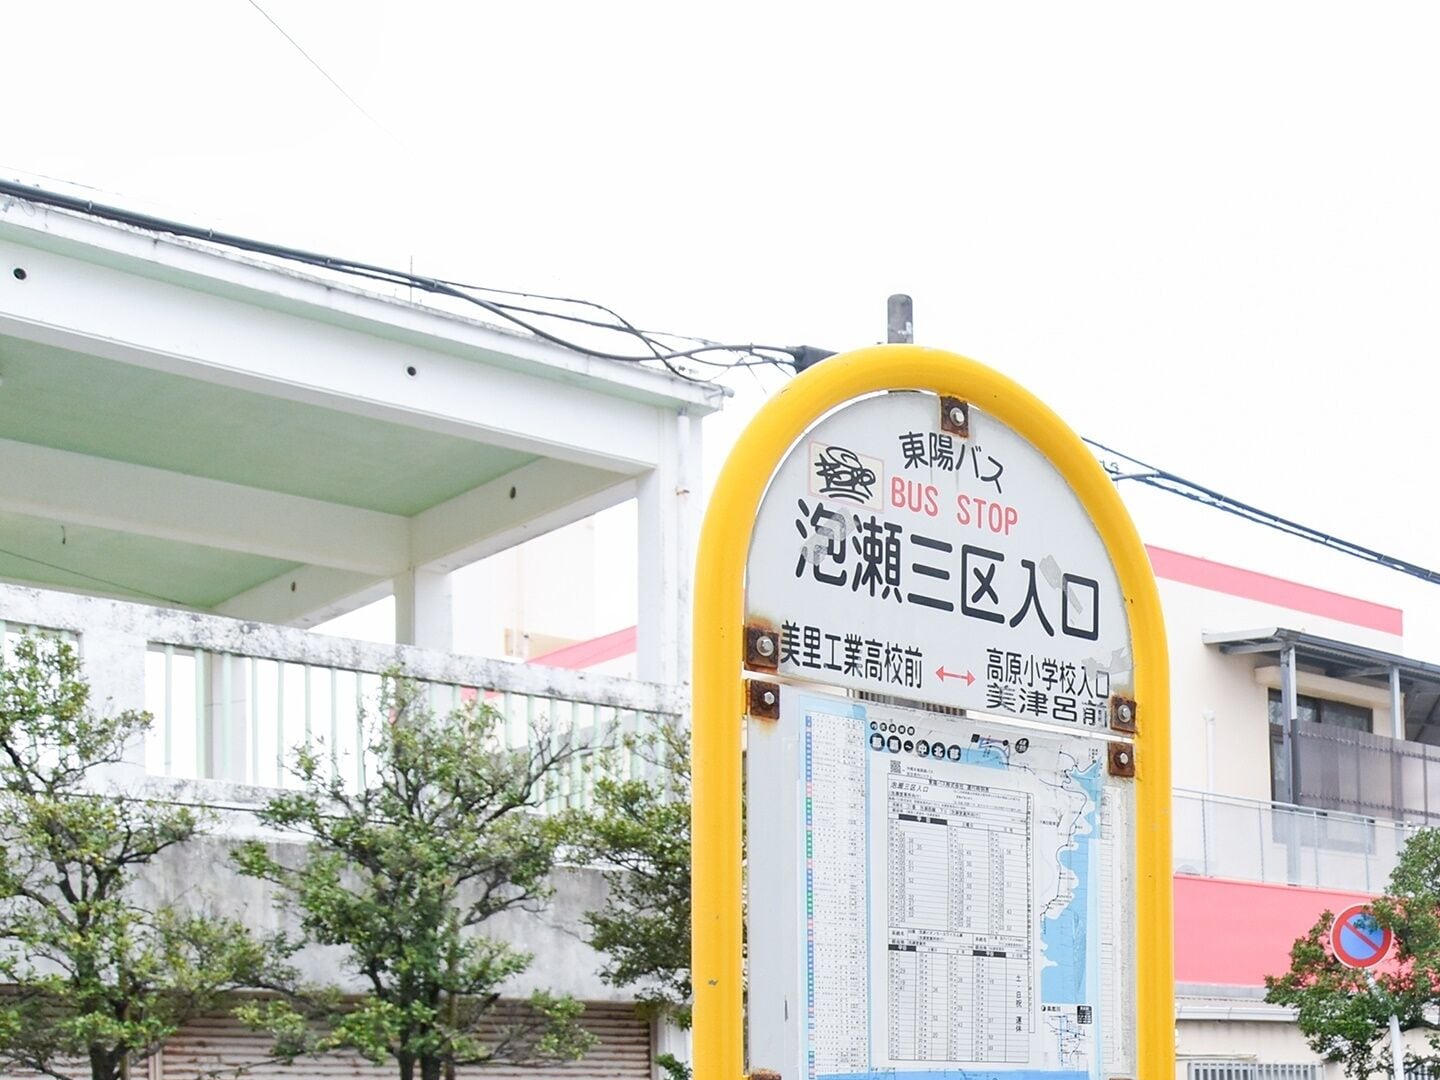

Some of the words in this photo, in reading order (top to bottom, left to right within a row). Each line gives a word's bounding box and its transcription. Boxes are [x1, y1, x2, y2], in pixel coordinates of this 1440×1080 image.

[899, 431, 1004, 493] 東陽バス
[890, 476, 939, 517] BUS
[957, 494, 1018, 536] STOP
[795, 498, 1100, 642] 泡瀬三区入口
[780, 619, 923, 689] 美里工業高校前
[986, 648, 1110, 699] 高原小学校入口
[986, 682, 1108, 728] 美津呂前
